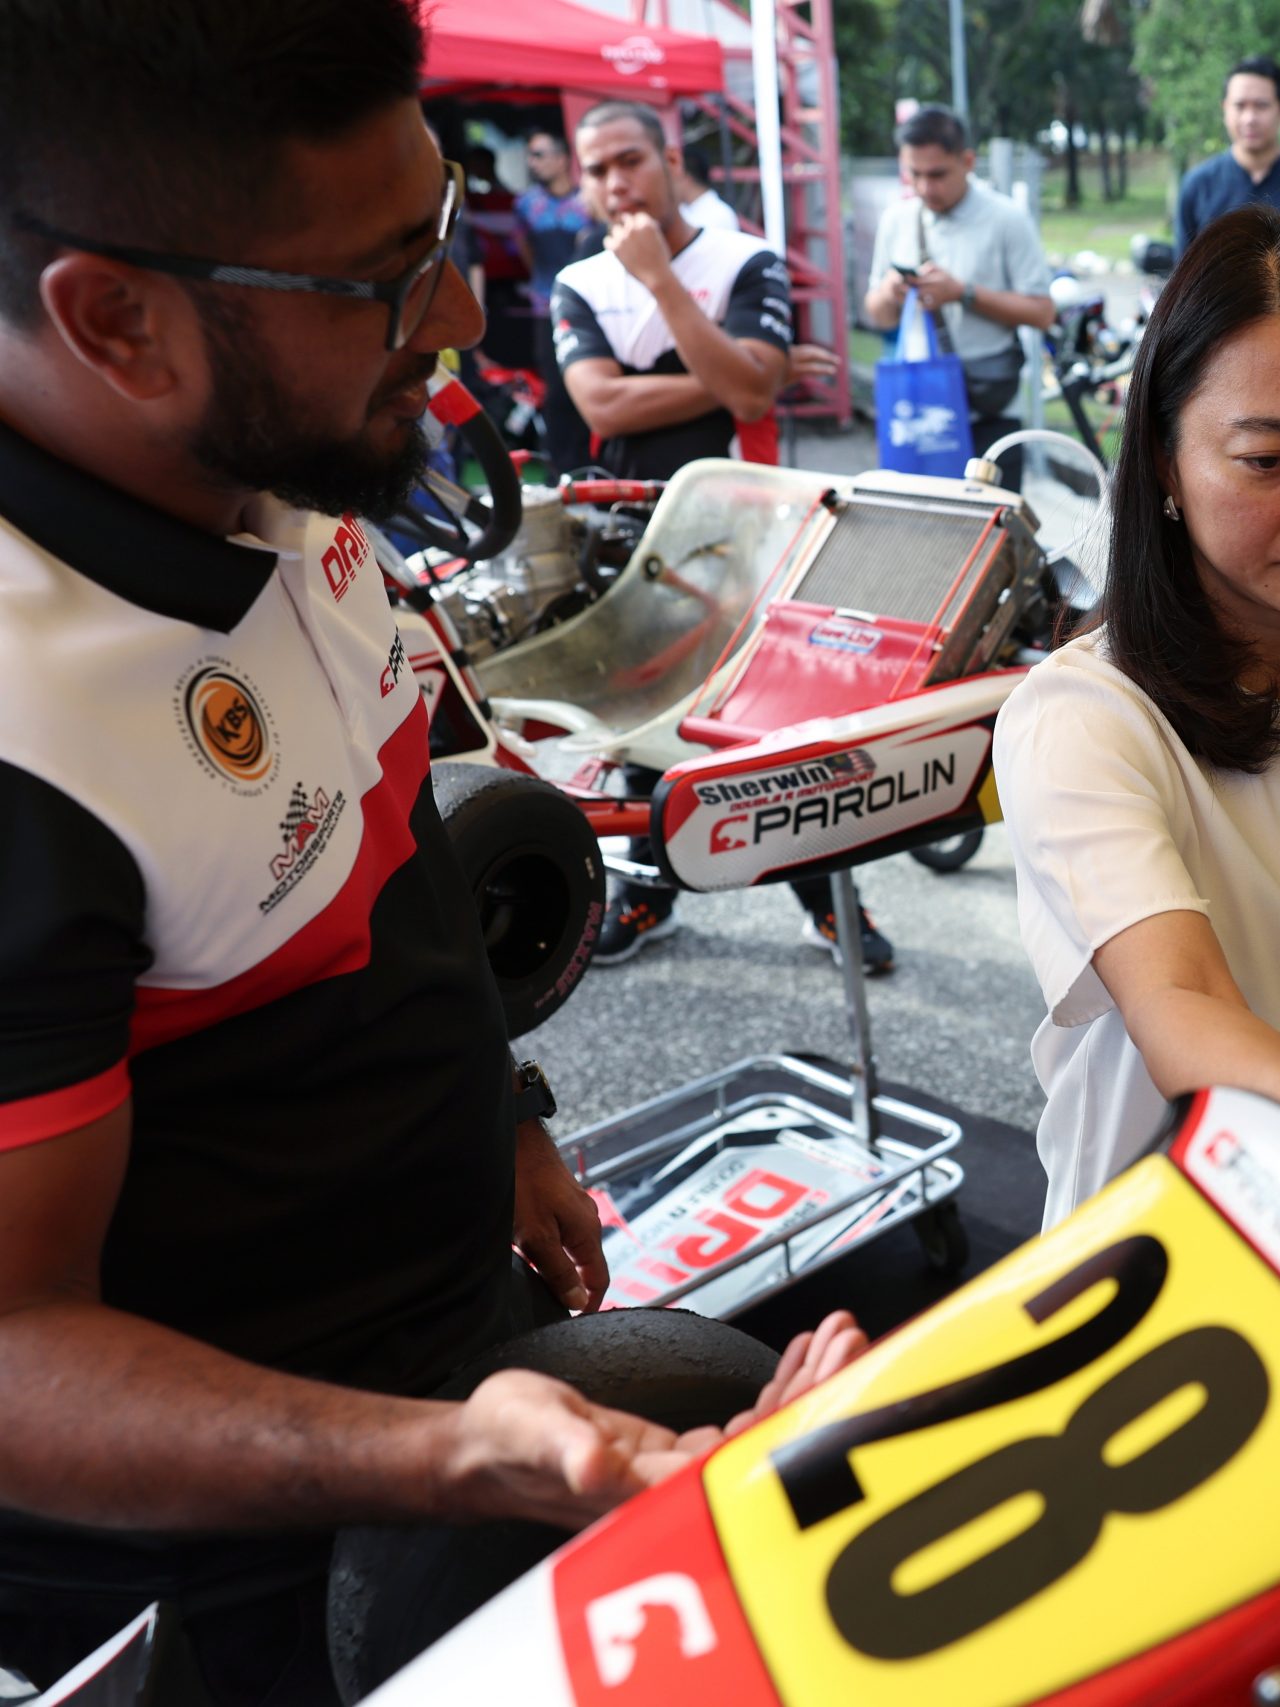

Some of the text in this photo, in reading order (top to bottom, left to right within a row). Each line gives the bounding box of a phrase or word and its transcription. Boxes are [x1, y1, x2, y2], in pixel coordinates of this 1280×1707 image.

[216, 697, 248, 743] KBS
[697, 762, 832, 806] Sherwin
[730, 794, 783, 813] DOUBLE
[796, 771, 875, 799] MOTORSPORT
[753, 753, 955, 845] PAROLIN
[258, 790, 343, 911] MOTORSPORTS
[269, 786, 330, 881] MAM
[770, 1233, 1271, 1661] 28
